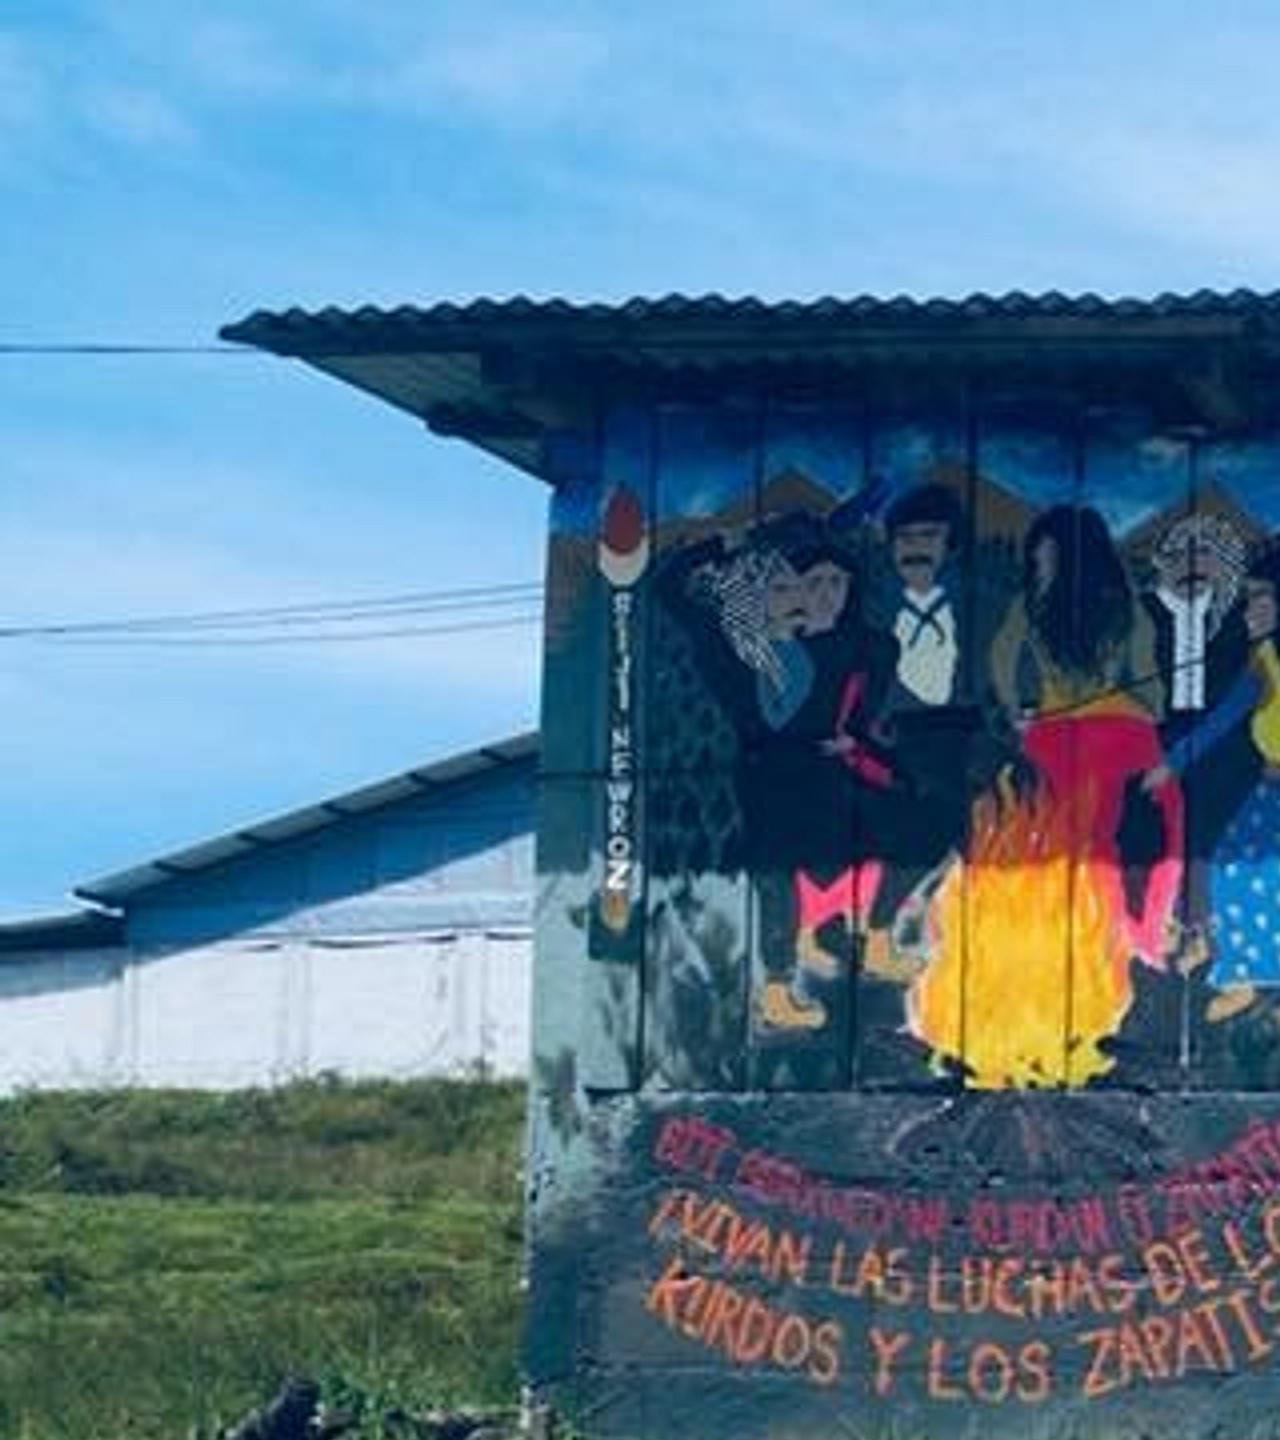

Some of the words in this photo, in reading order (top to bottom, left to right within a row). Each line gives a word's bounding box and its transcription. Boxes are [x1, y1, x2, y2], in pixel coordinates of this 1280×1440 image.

[646, 1260, 843, 1386] KURDOS
[868, 1332, 911, 1396] Y
[927, 1341, 1054, 1402] LOS
[830, 1240, 914, 1308] LAS
[926, 1246, 1136, 1321] LUCHAS
[1151, 1224, 1220, 1303] DE
